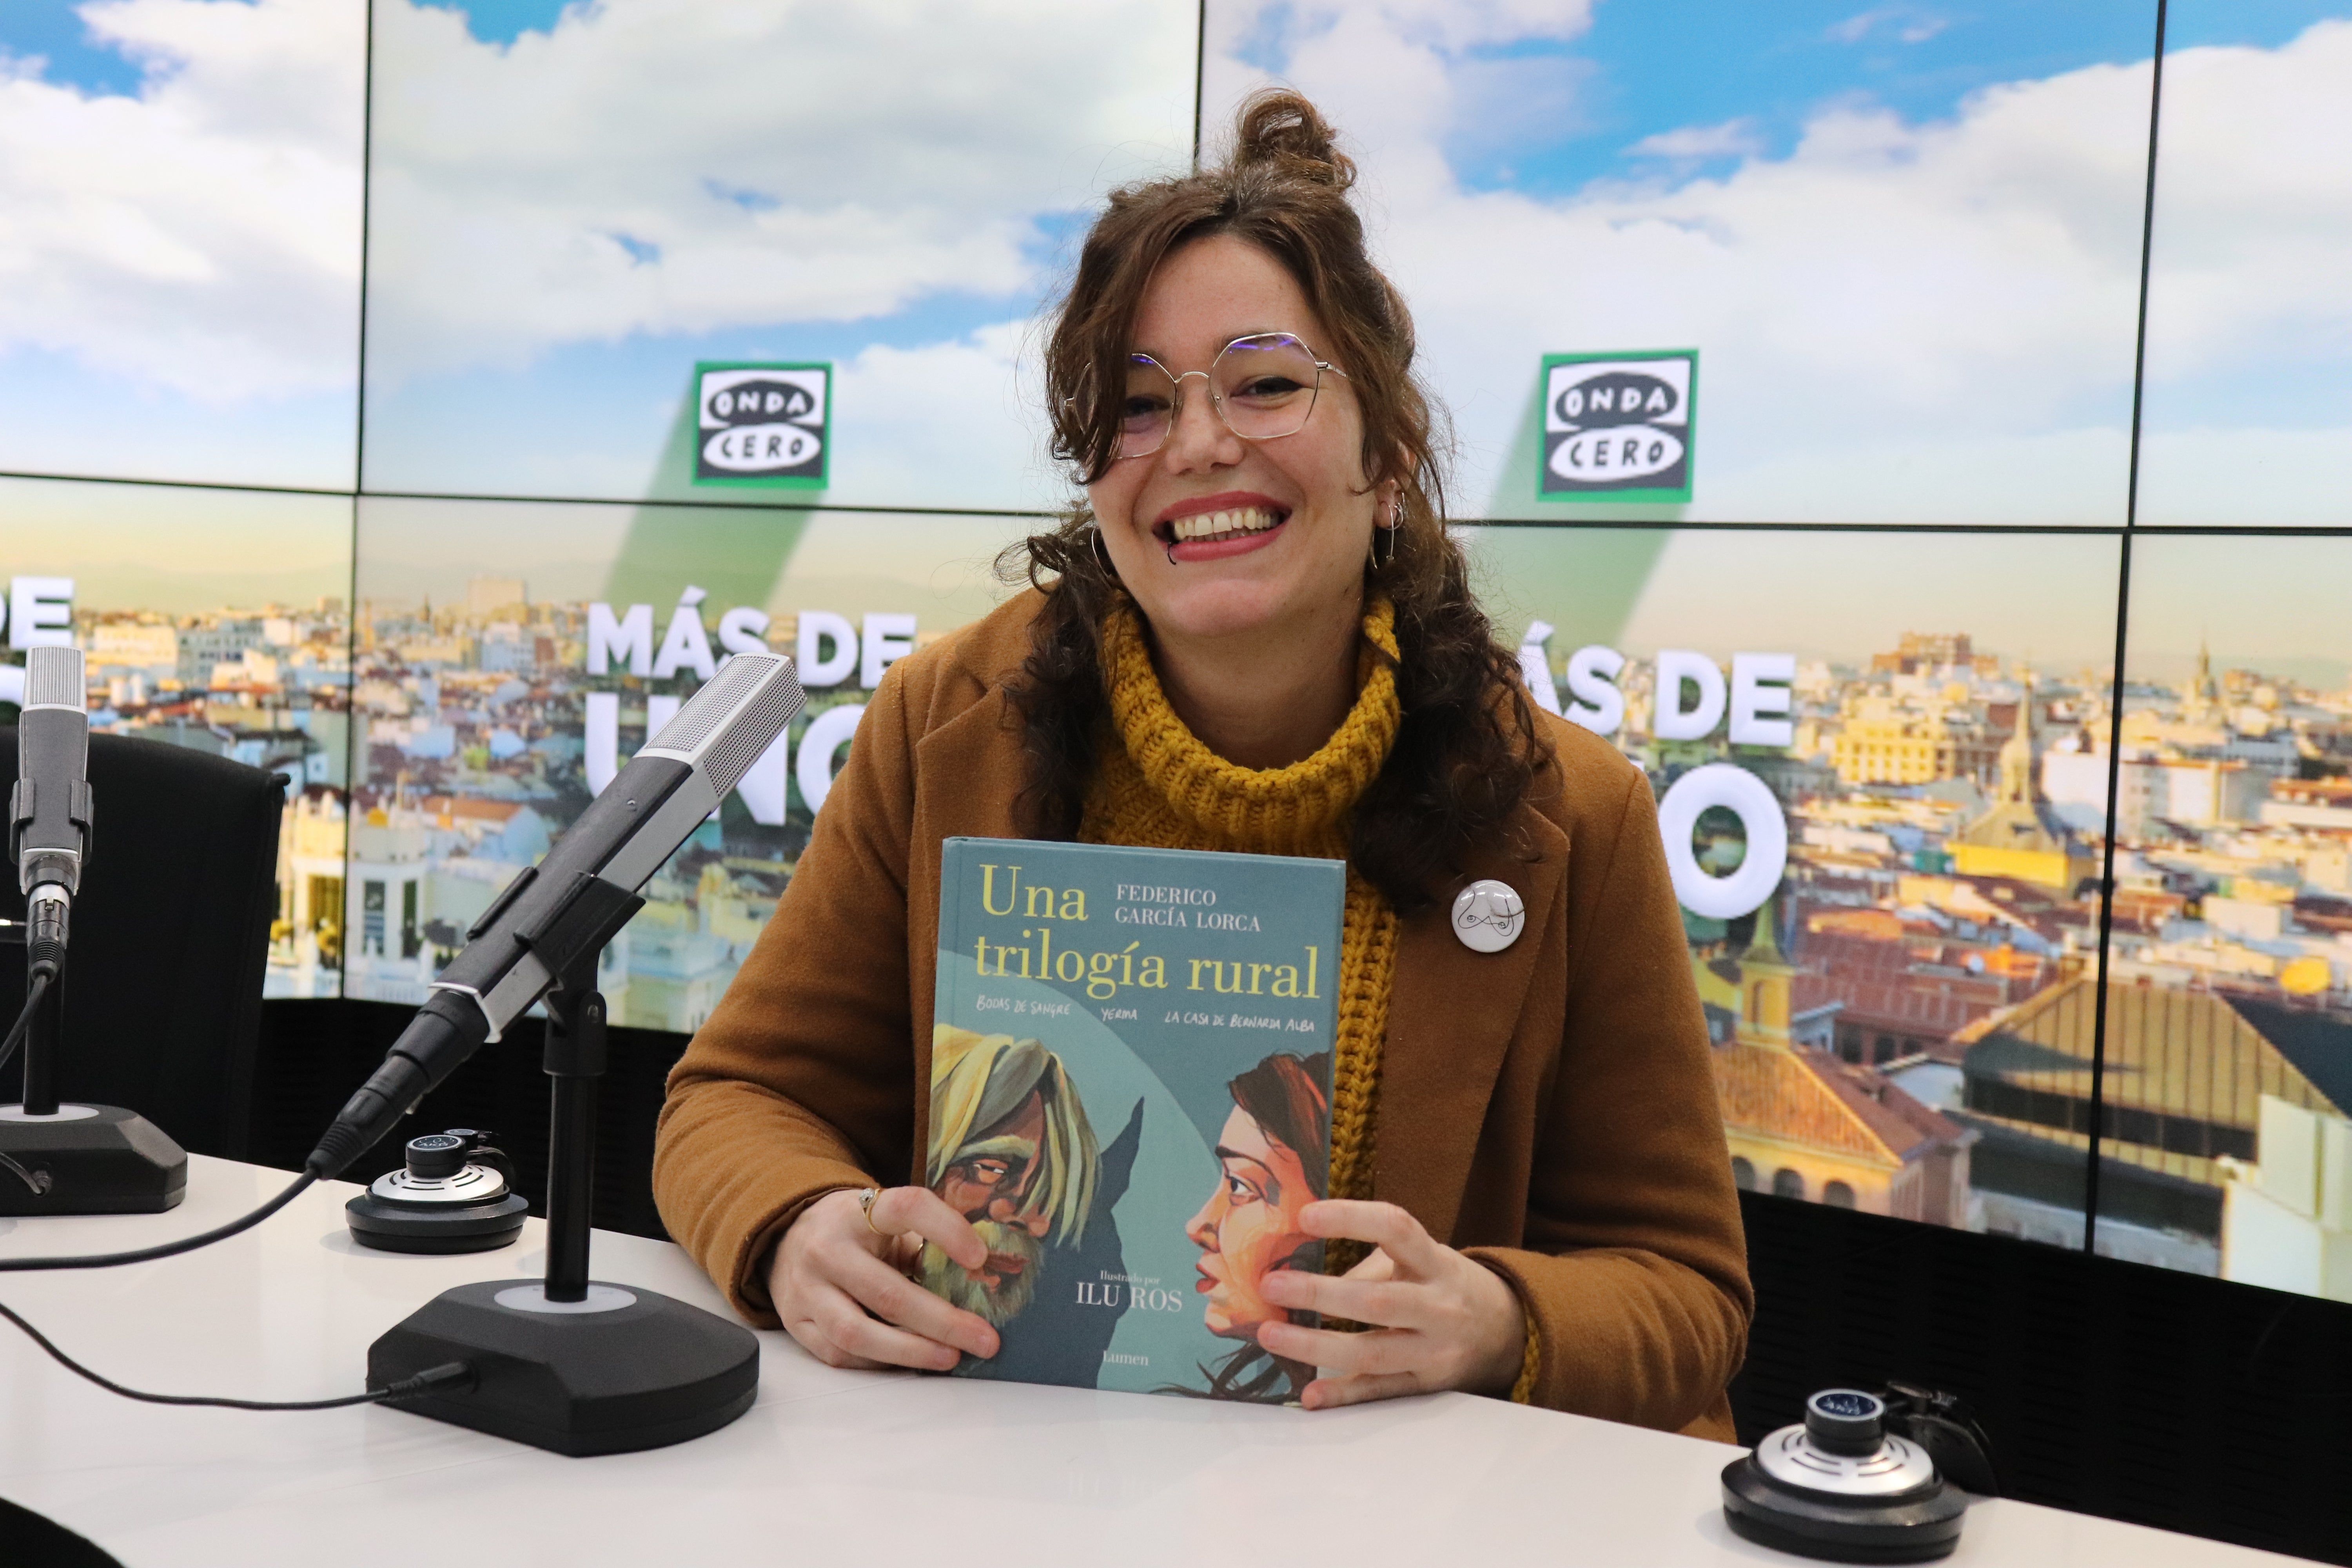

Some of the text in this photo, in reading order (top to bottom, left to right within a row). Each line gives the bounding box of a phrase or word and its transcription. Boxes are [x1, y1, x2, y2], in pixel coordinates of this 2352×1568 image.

[715, 391, 808, 416] ONDA
[1565, 386, 1667, 417] ONDA
[722, 434, 804, 459] CERO
[1569, 437, 1666, 468] CERO
[0, 576, 74, 650] E
[797, 610, 916, 689] DE
[1519, 621, 1795, 747] ÁS DE
[979, 864, 1088, 921] Una
[1117, 884, 1216, 906] FEDERICO
[1115, 906, 1261, 932] GARCÍA LORCA
[974, 928, 1321, 1000] trilogía rural
[976, 994, 1072, 1018] BODAS DE SANGRE
[1101, 1007, 1137, 1022] YERMA
[1165, 1011, 1315, 1032] LA CASA DE BERNARDA ALBA
[1100, 1270, 1160, 1286] Ilustrado por
[1076, 1281, 1183, 1312] ILU ROS
[1103, 1350, 1149, 1366] Lumen
